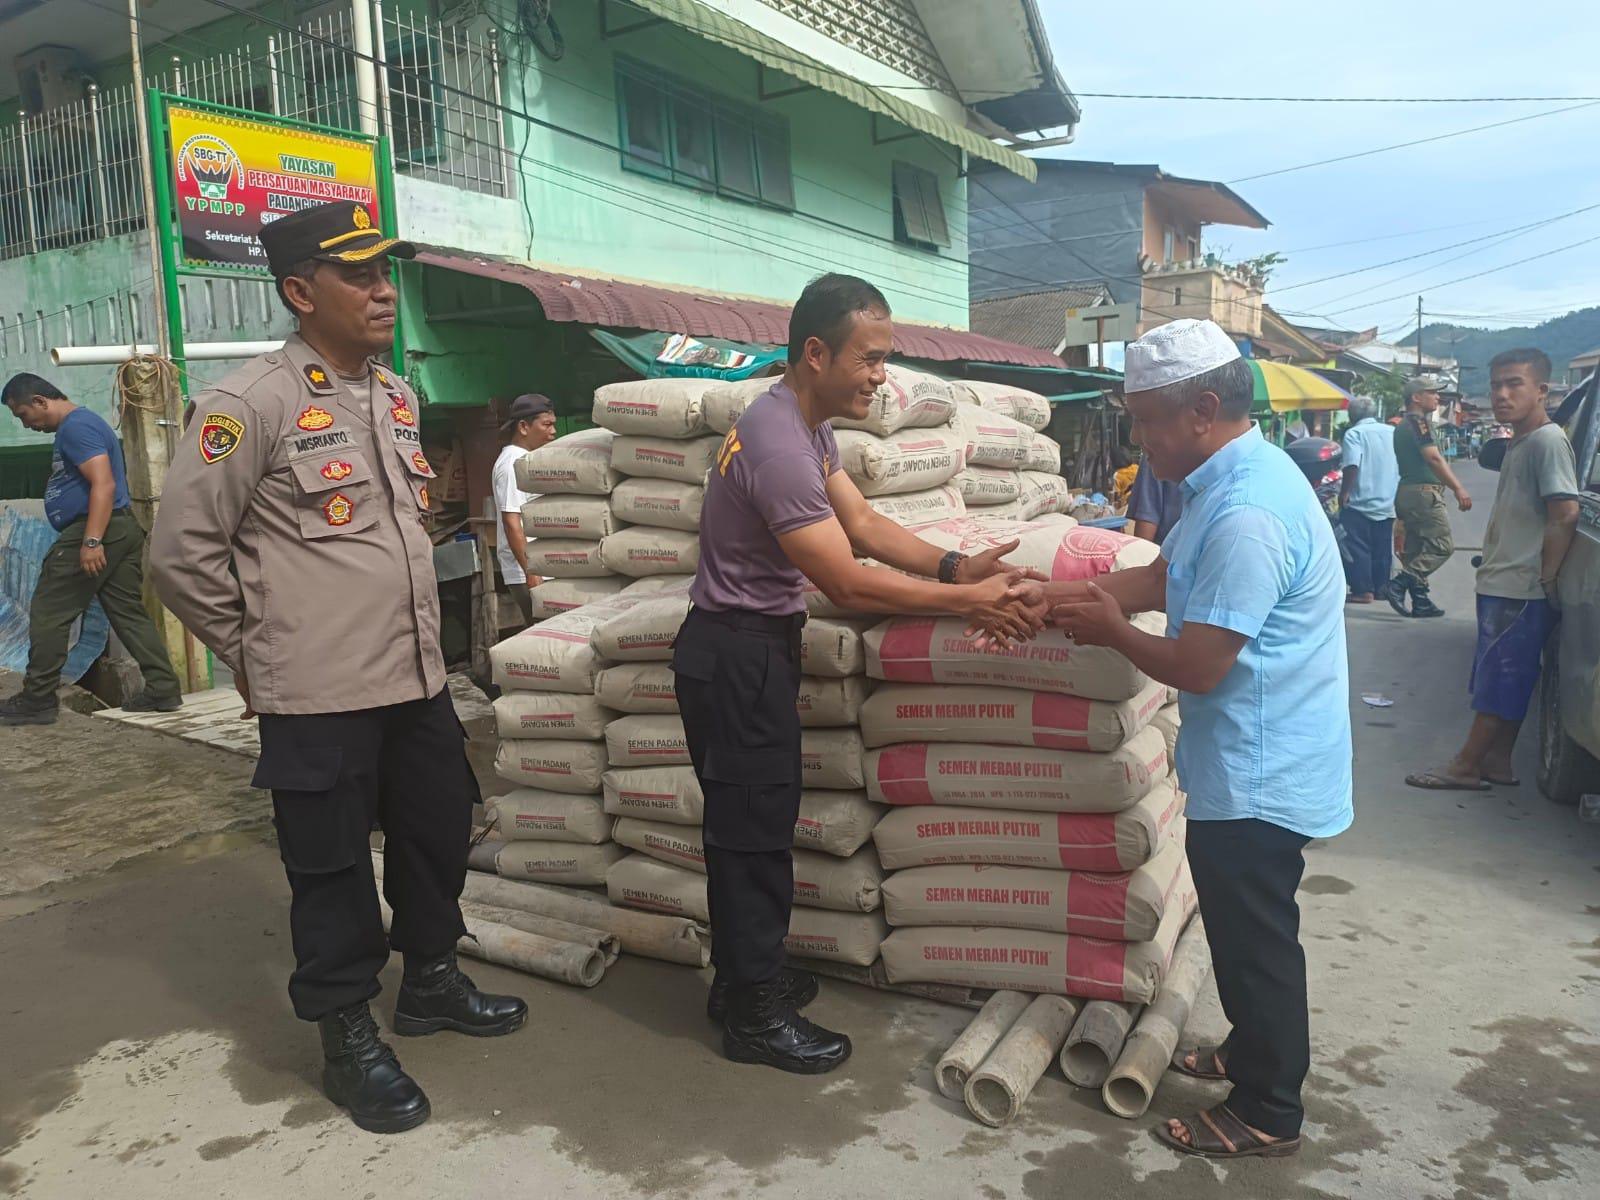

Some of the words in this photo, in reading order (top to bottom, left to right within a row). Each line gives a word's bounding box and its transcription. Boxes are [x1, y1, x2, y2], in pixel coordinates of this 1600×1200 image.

[194, 147, 227, 163] SBG-TT
[279, 155, 335, 177] YAYASAN
[249, 171, 308, 193] PERSATUAN
[308, 179, 371, 202] MASYARAKAT
[267, 193, 310, 211] PADANG
[205, 230, 252, 244] Sekretariat
[207, 416, 241, 434] LOGISTIK
[294, 431, 348, 453] MISRIANTO
[903, 458, 930, 473] PADANG
[931, 455, 951, 470] SEMEN
[617, 634, 642, 644] SEMEN
[643, 632, 676, 642] PADANG
[505, 662, 530, 672] SEMEN
[530, 664, 560, 674] PADANG
[896, 705, 933, 719] SEMEN
[935, 704, 976, 719] MERAH
[978, 704, 1015, 718] PUTIH
[520, 721, 550, 729] PADANG
[628, 740, 655, 748] SEMEN
[520, 757, 542, 768] SEMEN
[542, 759, 571, 770] PADANG
[802, 761, 822, 770] SEM
[938, 760, 977, 775] SEMEN
[980, 760, 1022, 776] MERAH
[1024, 763, 1063, 778] PUTIH
[619, 798, 650, 808] PADANG
[651, 800, 678, 810] SEMEN
[916, 822, 955, 838] SEMEN
[958, 821, 1000, 837] MERAH
[1003, 822, 1041, 837] PUTIH
[644, 834, 671, 848] SEMEN
[524, 860, 547, 868] SEMEN
[622, 888, 648, 899] SEMEN
[649, 890, 682, 906] PADANG
[925, 887, 965, 902] SEMEN
[967, 887, 1009, 903] MERAH
[1012, 890, 1050, 905] PUTIH
[924, 946, 963, 961] SEMEN
[965, 947, 1008, 964] MERAH
[1011, 949, 1049, 966] PUTIH
